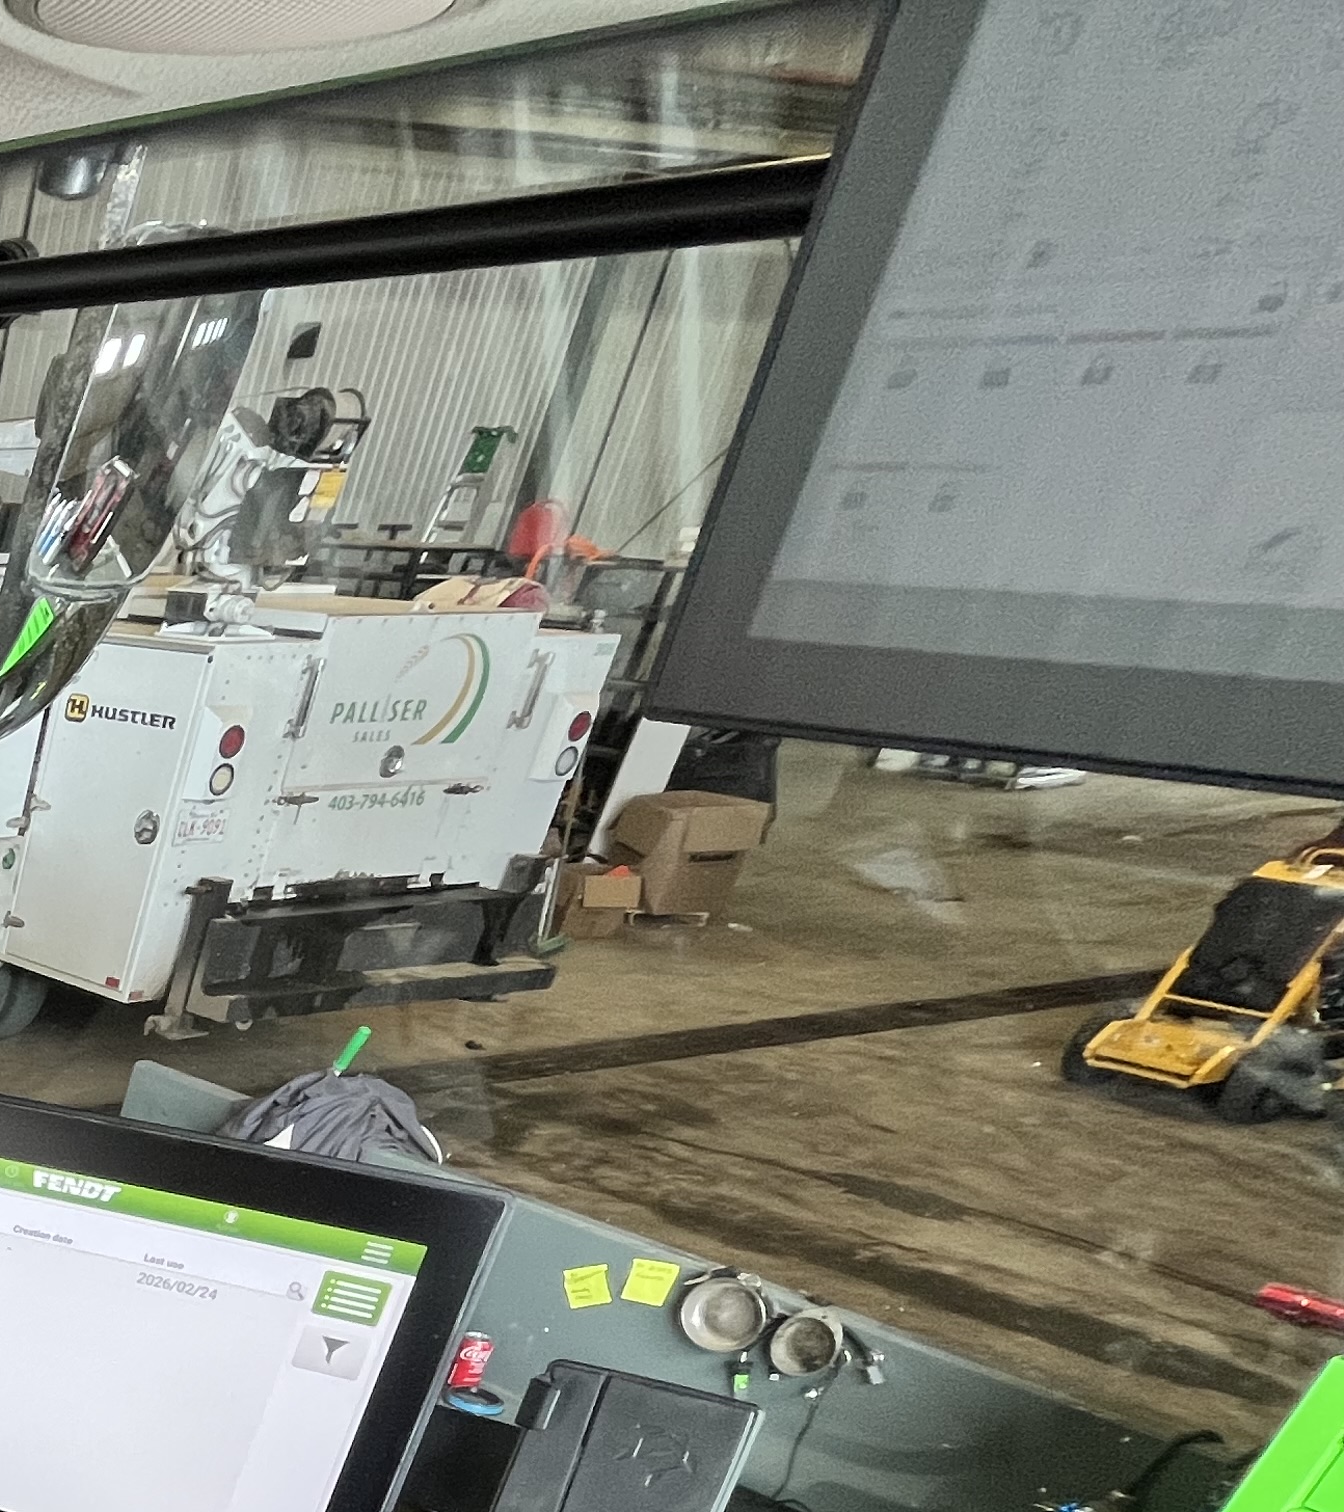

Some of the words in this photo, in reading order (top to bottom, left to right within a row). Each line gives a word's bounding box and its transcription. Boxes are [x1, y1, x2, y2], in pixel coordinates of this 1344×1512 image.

[90, 704, 177, 730] HUSTLER
[329, 697, 428, 725] PALLISER
[352, 729, 391, 743] SALES
[32, 1169, 122, 1202] FENDT
[13, 1224, 51, 1242] Creation
[52, 1233, 74, 1245] date
[143, 1253, 165, 1267] Last
[166, 1258, 185, 1270] use
[136, 1271, 218, 1300] 2026/02/24
